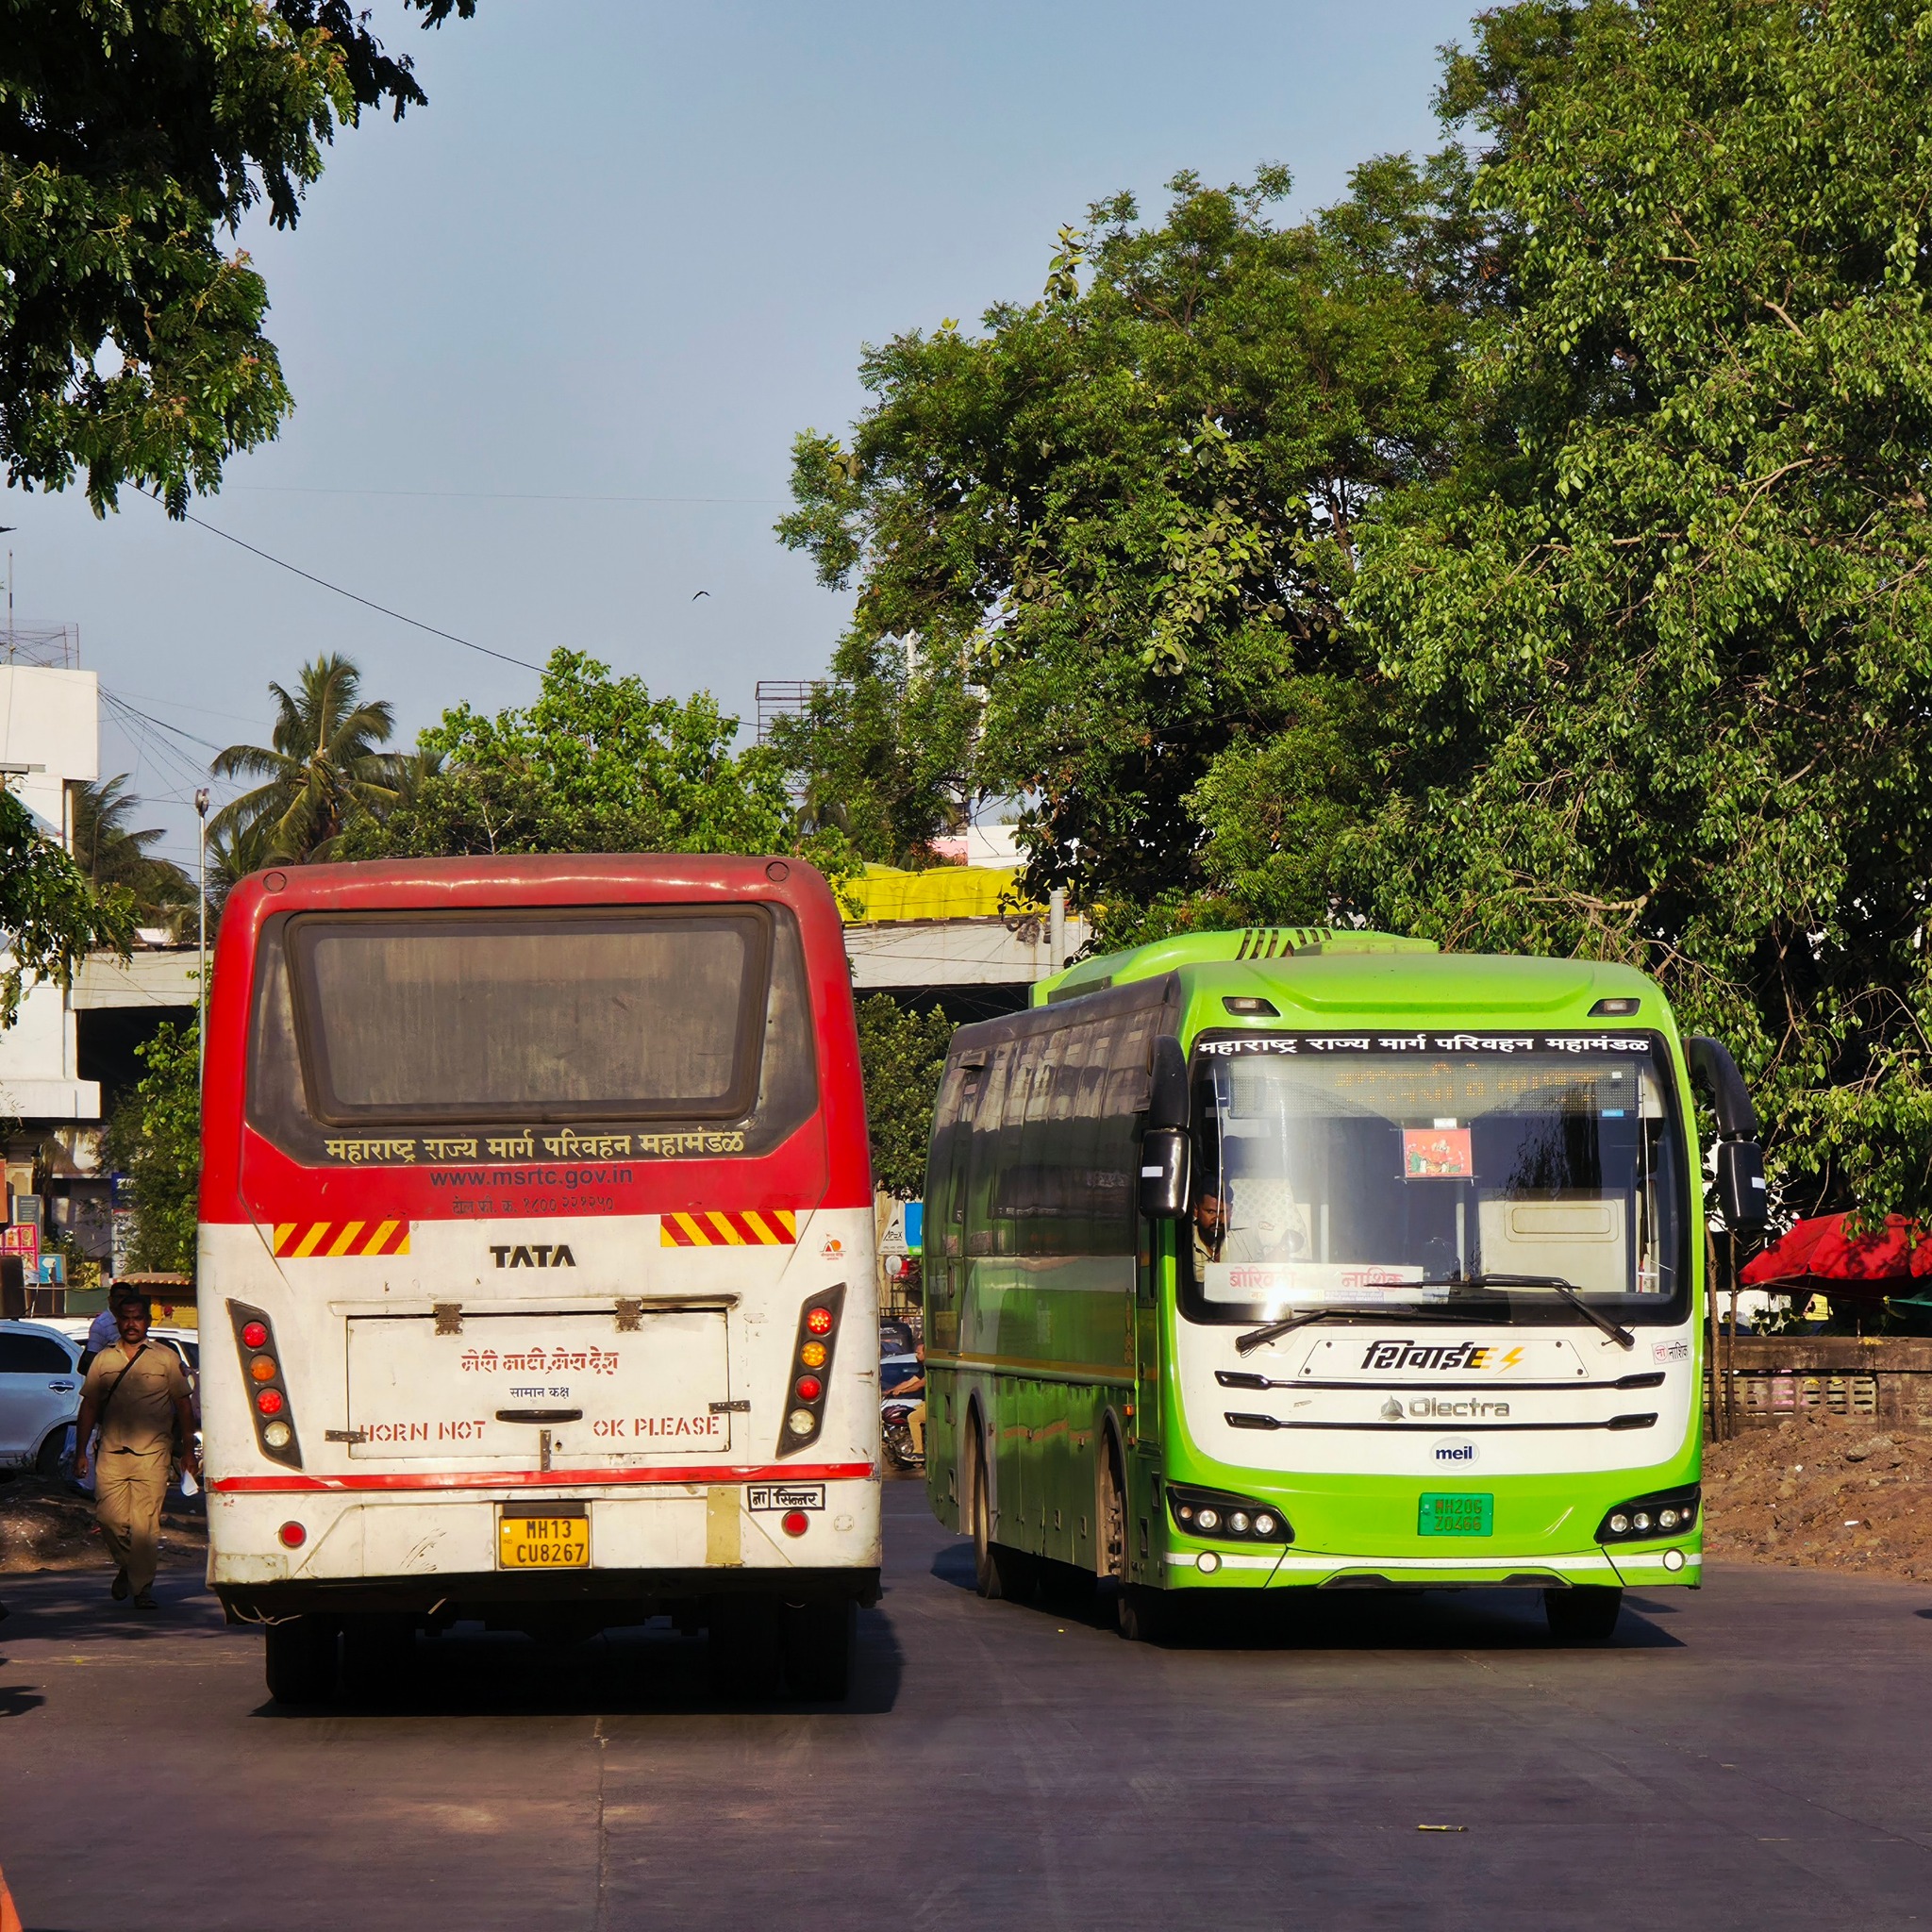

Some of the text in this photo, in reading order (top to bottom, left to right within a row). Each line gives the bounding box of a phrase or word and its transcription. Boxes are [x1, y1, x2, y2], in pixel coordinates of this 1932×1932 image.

[1199, 1034, 1649, 1056] महाराष्ट्र राज्य मार्ग परिवहन महामंडळ
[324, 1126, 744, 1164] महाराष्ट्र राज्य मार्ग परिवहन महामंडळ
[430, 1165, 633, 1190] www.msrtc.gov.in
[490, 1244, 576, 1268] TATA
[509, 1387, 569, 1400] सामान कक्ष
[1408, 1397, 1510, 1417] Olectra
[359, 1421, 486, 1441] HORN NOT
[593, 1416, 720, 1437] OK PLEASE
[1436, 1446, 1473, 1459] meil
[526, 1520, 572, 1539] MH13
[516, 1542, 584, 1563] CU8267
